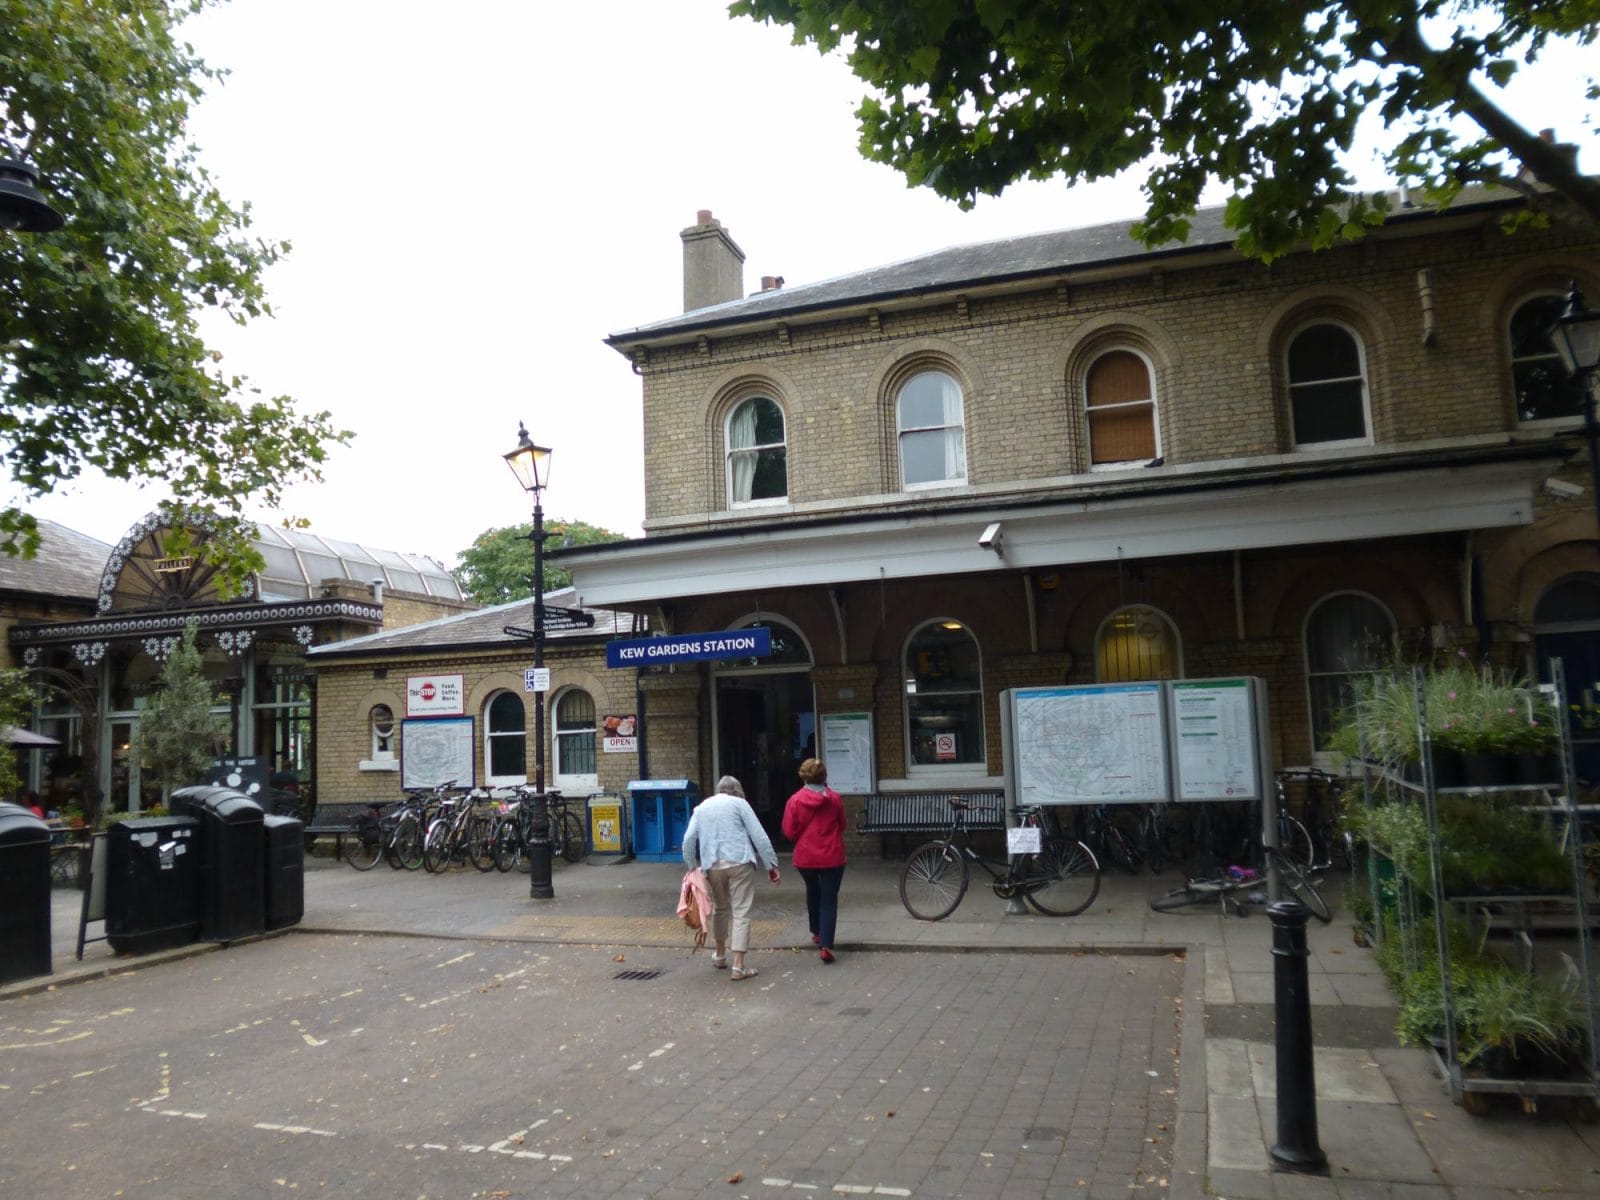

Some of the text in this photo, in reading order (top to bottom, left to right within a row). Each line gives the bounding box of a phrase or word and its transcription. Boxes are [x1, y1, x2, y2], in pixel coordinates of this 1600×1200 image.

[620, 637, 755, 659] KEW GARDENS STATION
[610, 738, 631, 746] OPEN
